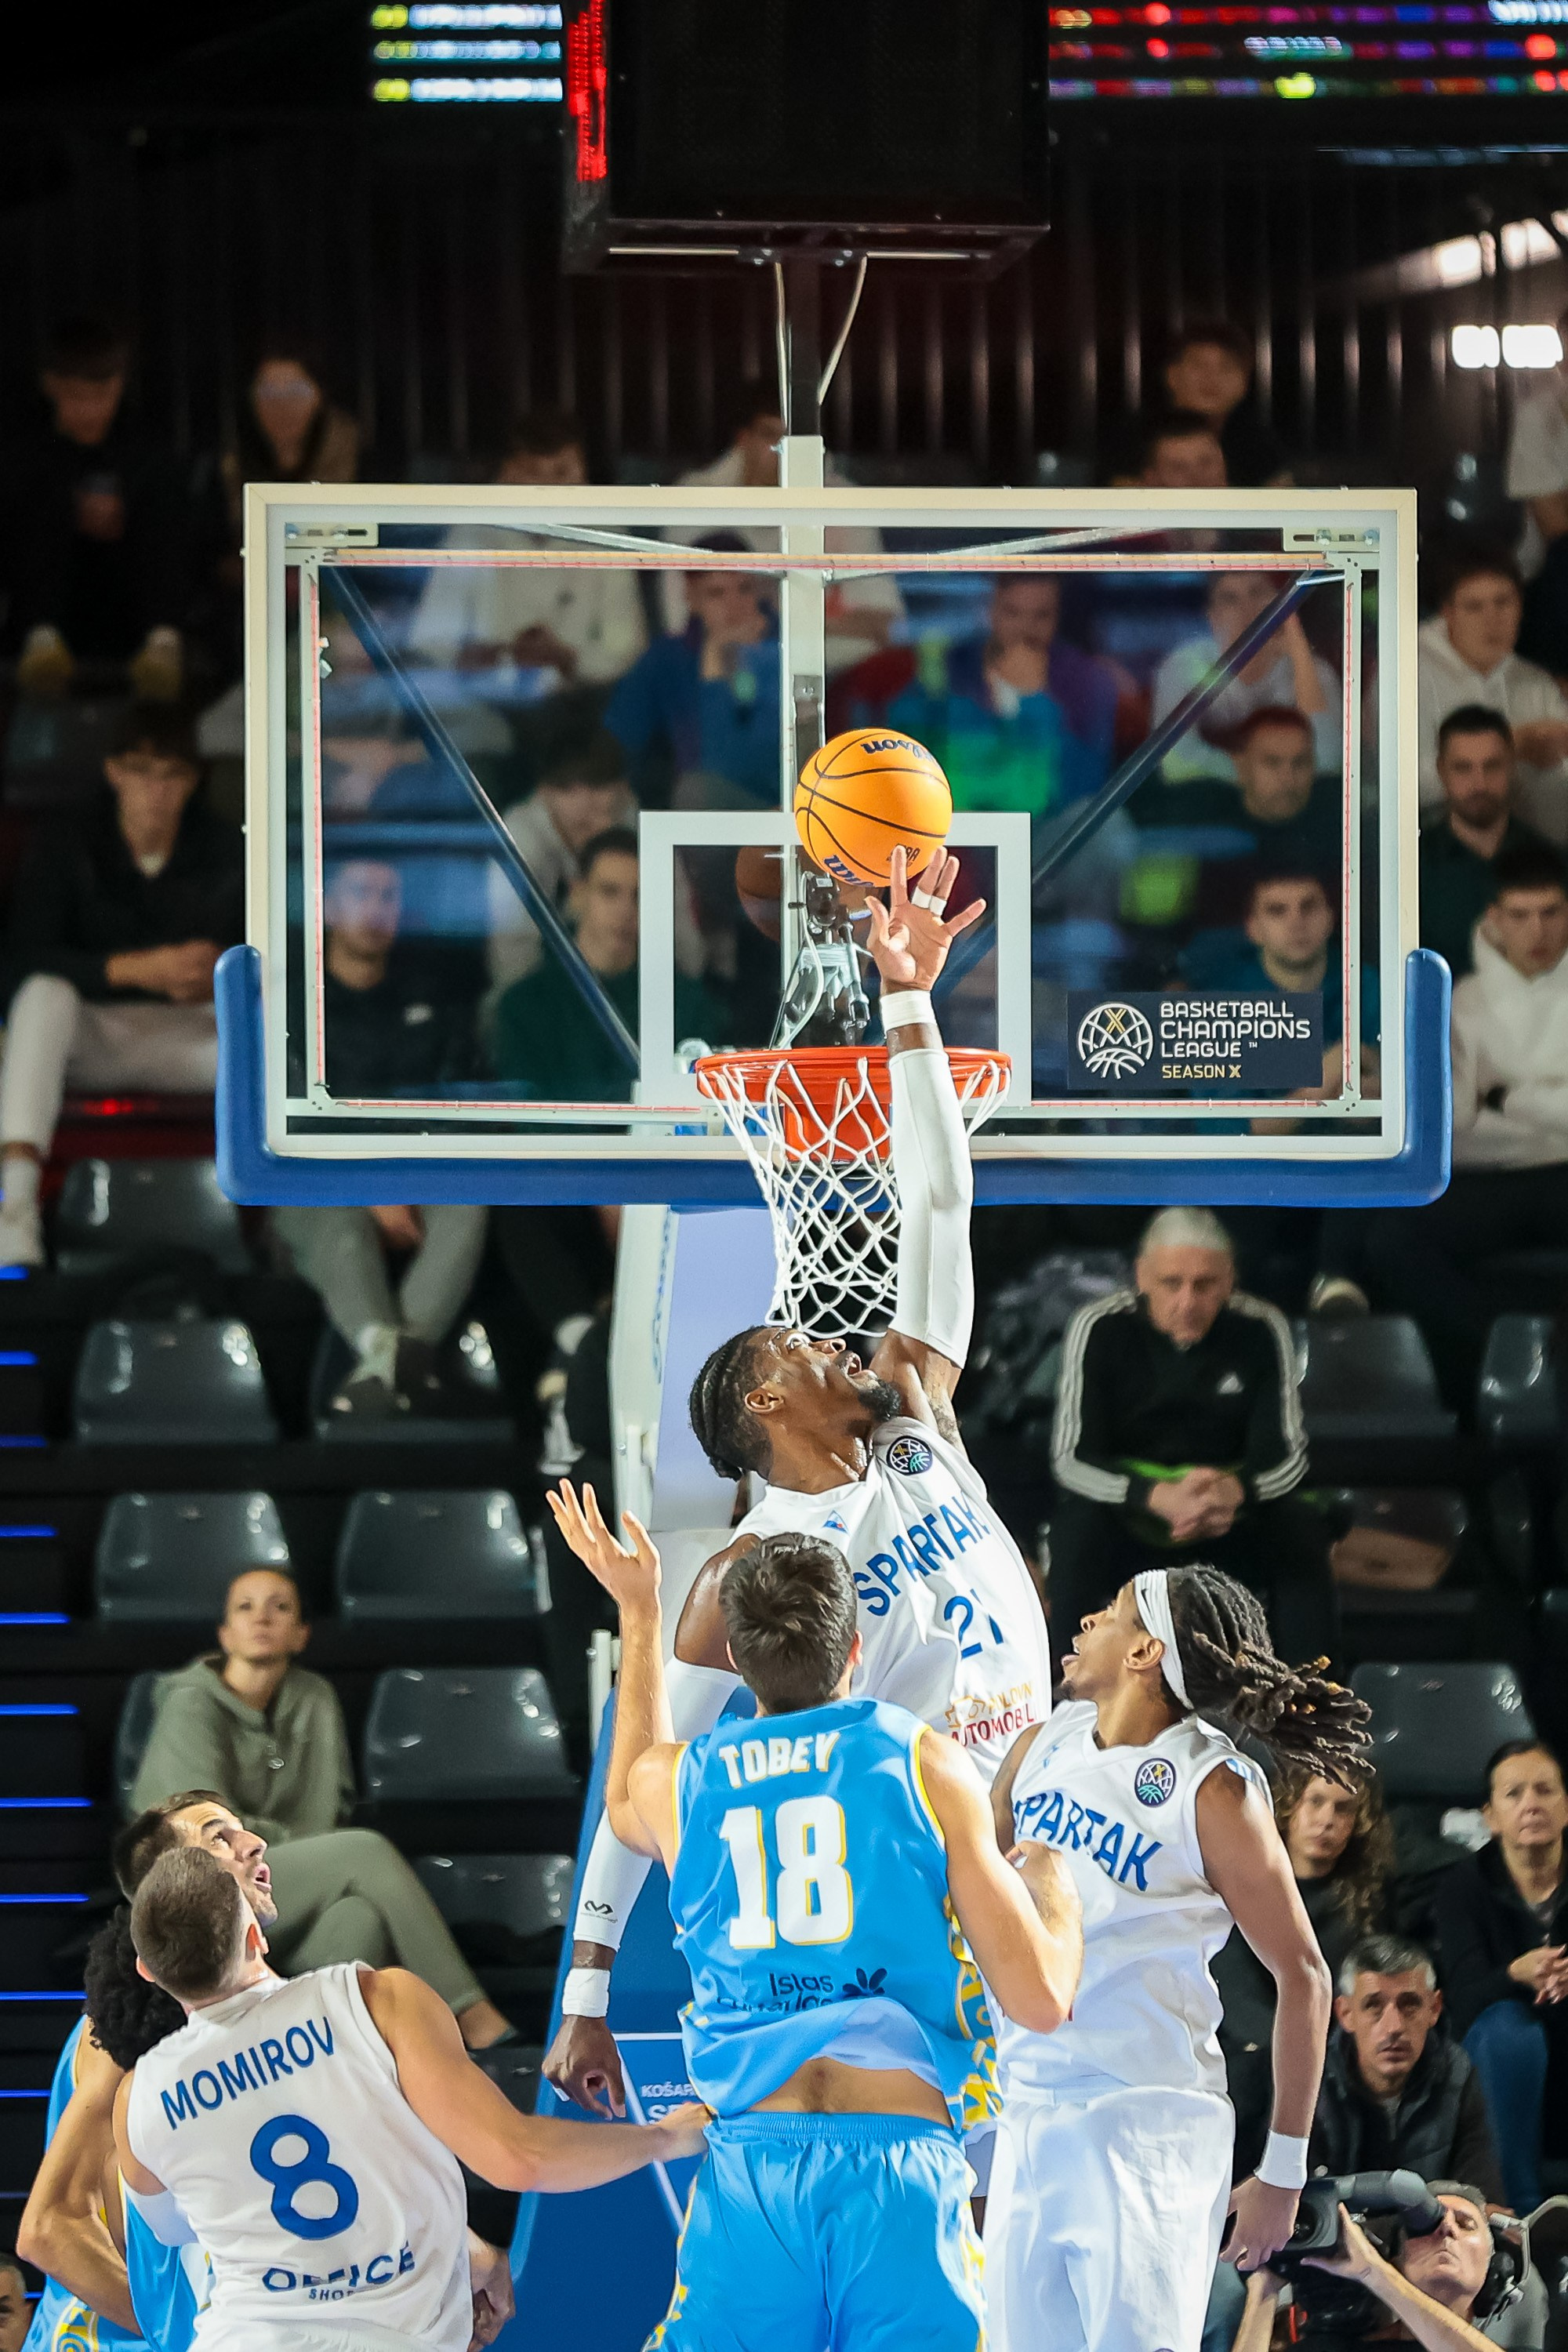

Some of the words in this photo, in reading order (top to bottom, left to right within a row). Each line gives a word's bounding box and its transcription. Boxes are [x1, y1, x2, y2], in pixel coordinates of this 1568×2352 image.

[1160, 1001, 1294, 1018] BASKETBALL
[1160, 1020, 1311, 1039] CHAMPIONS
[1160, 1041, 1242, 1058] LEAGUE
[1162, 1065, 1225, 1078] SEASON
[1229, 1065, 1242, 1078] X
[853, 1490, 990, 1617] SPARTAK
[718, 1731, 840, 1789] TOBEY
[1014, 1791, 1163, 1892] PARTAK
[718, 1795, 853, 1950] 18
[769, 1972, 834, 1997] Islas
[160, 2016, 335, 2130] MOMIROV
[249, 2114, 359, 2241] 8
